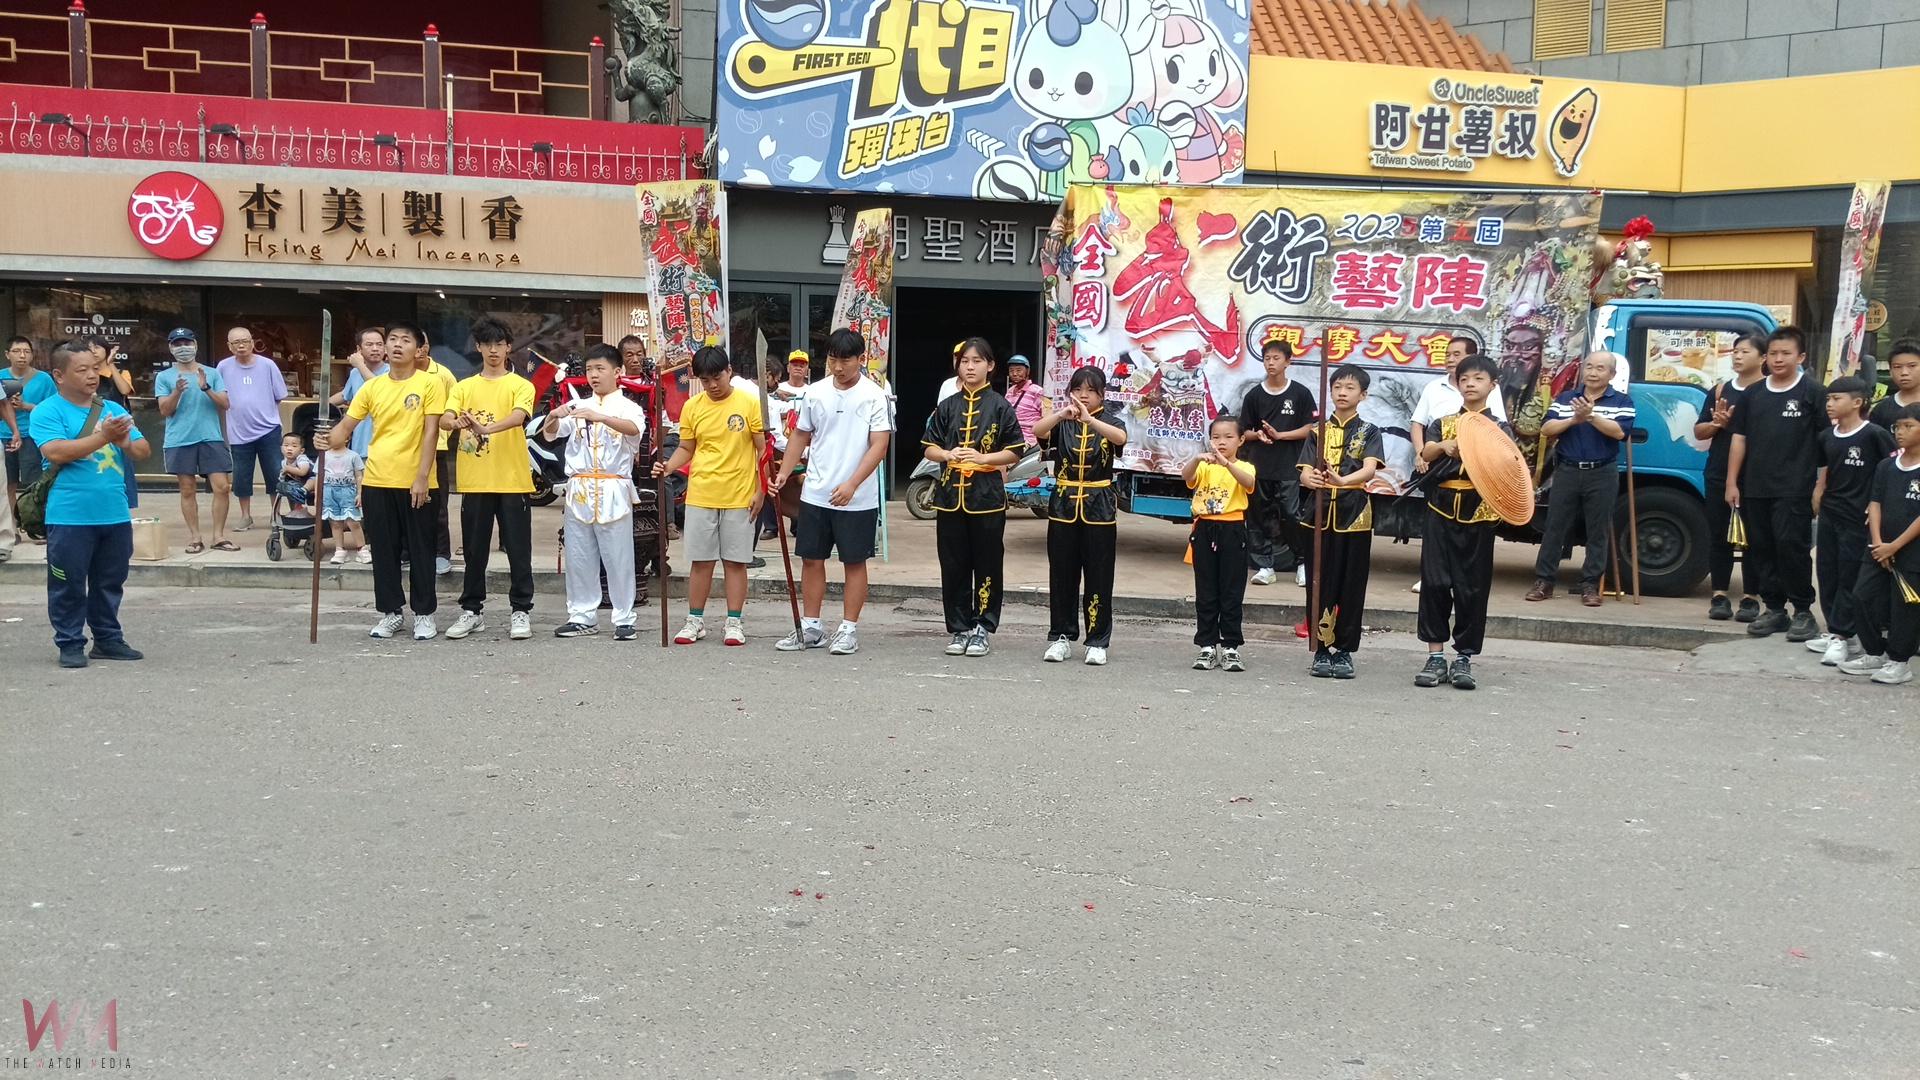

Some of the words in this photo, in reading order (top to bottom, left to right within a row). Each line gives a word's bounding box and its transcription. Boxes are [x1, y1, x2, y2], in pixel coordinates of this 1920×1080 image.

[793, 53, 842, 71] FIRST
[847, 51, 871, 65] GEN
[1455, 83, 1539, 106] UncleSweet
[842, 111, 950, 175] 彈珠台
[1374, 103, 1538, 157] 阿甘薯叔
[1374, 154, 1407, 166] Taiwan
[1410, 156, 1439, 167] Sweet
[1442, 157, 1472, 169] Potato
[640, 190, 658, 226] 全國
[244, 233, 323, 261] Hsing
[346, 238, 397, 261] Mei
[417, 241, 521, 268] Incense
[1072, 223, 1118, 334] 全國
[1332, 252, 1488, 312] 藝陣
[65, 325, 97, 335] OPEN
[100, 326, 131, 336] TIME
[1670, 337, 1707, 347] 可樂餅
